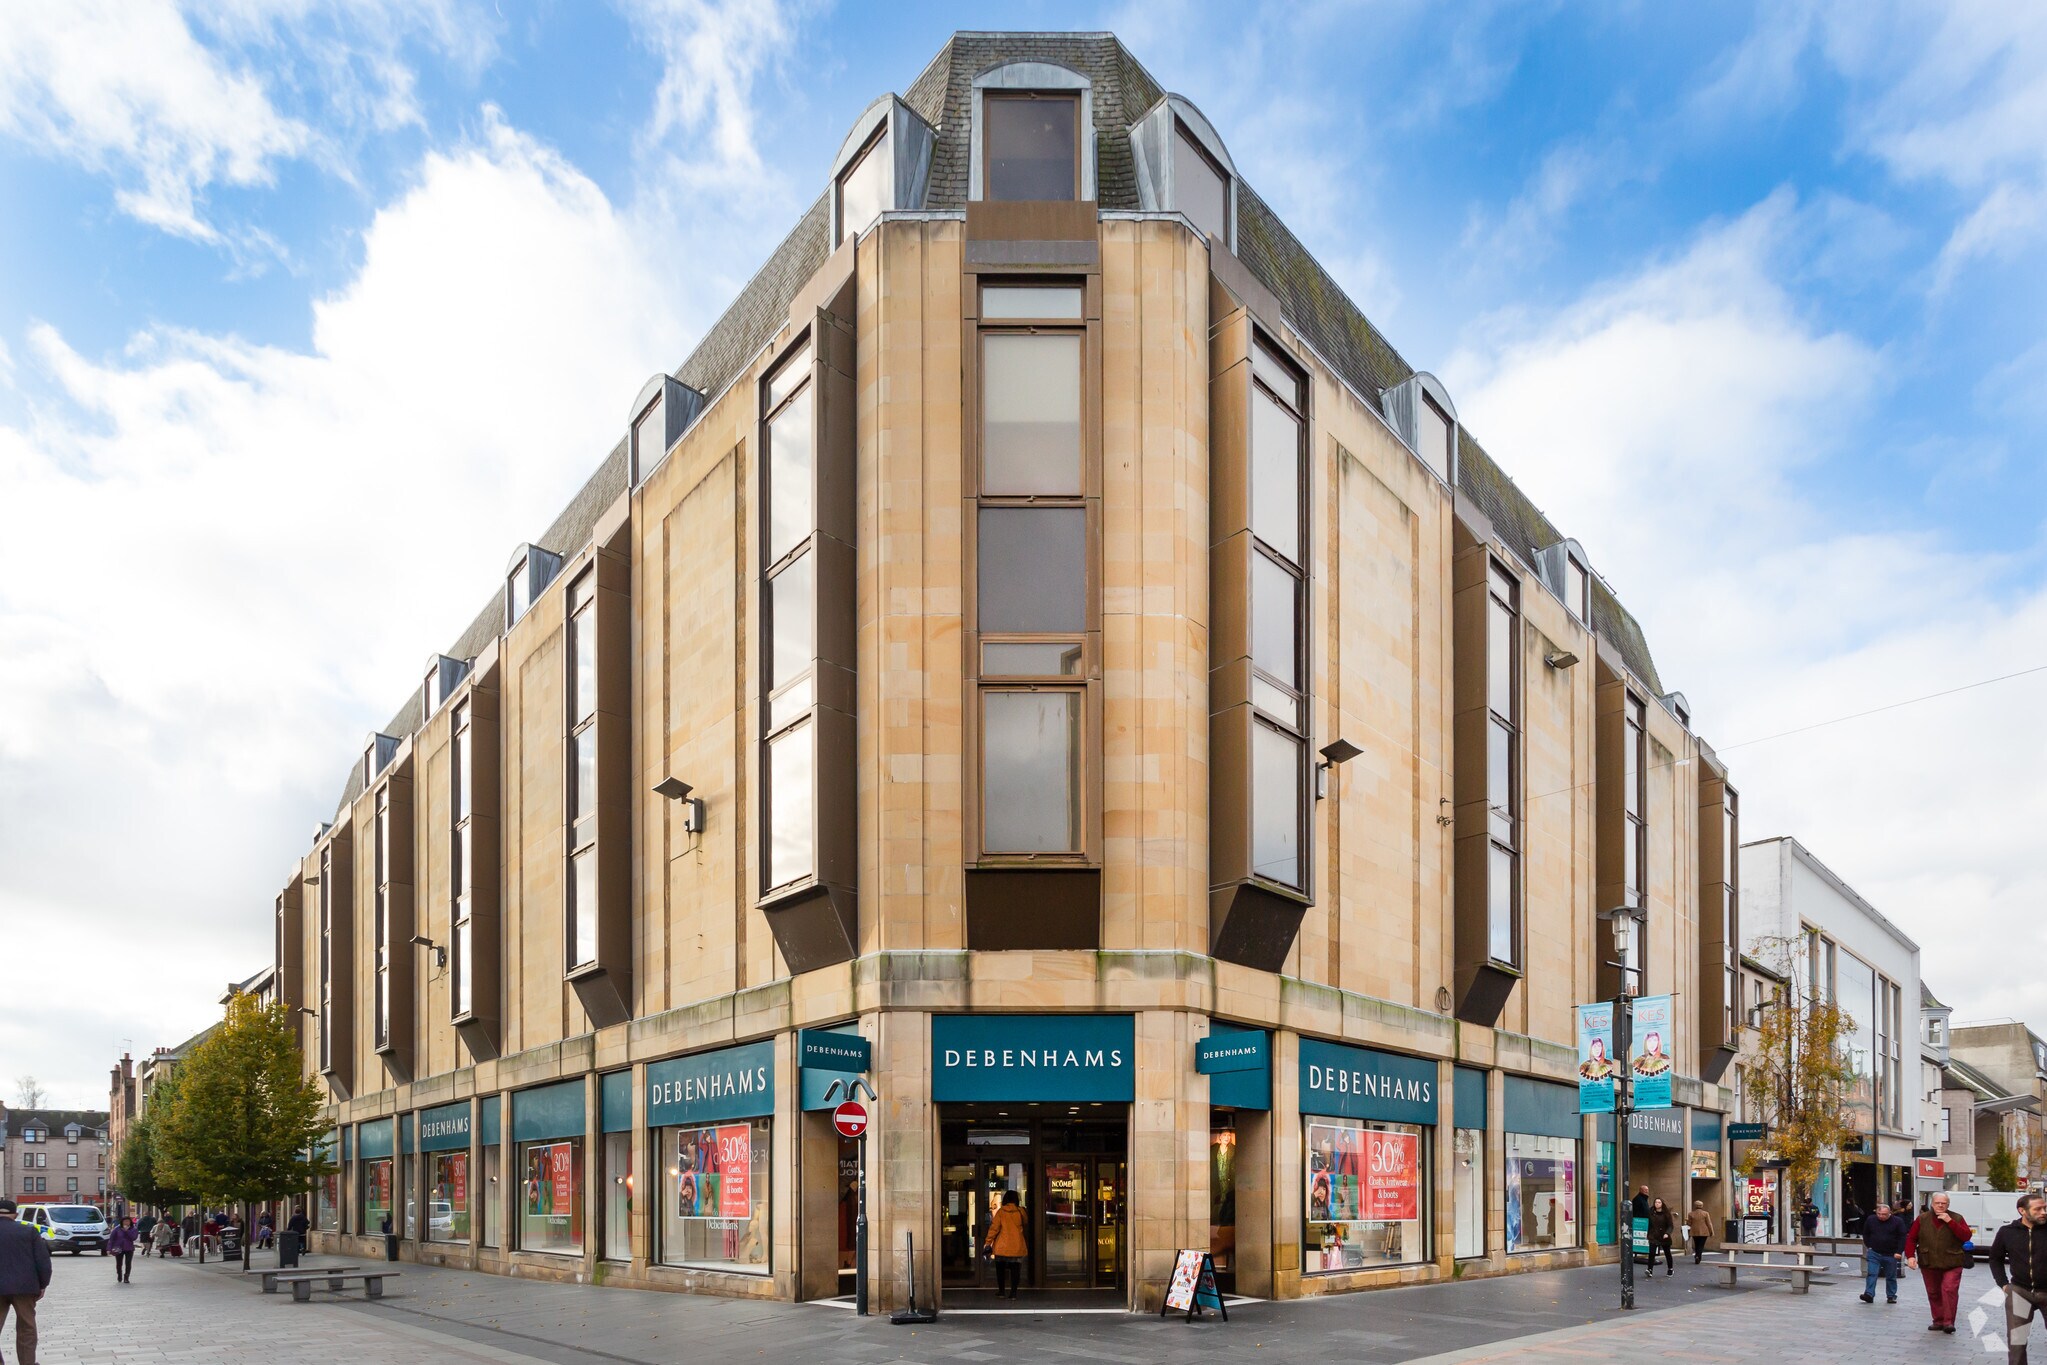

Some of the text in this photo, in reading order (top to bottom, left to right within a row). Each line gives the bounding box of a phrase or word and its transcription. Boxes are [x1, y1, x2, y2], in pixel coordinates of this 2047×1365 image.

[1584, 1015, 1608, 1029] KES
[1638, 1008, 1665, 1022] KES
[806, 1045, 863, 1058] DEBENHAMS
[945, 1050, 1122, 1067] DEBENHAMS
[1203, 1046, 1257, 1060] DEBENHAMS
[652, 1067, 766, 1105] DEBENHAMS
[1309, 1065, 1430, 1103] DEBENHAMS
[422, 1117, 469, 1138] DEBENHAMS
[1632, 1113, 1682, 1134] DEBENHAMS
[721, 1135, 747, 1162] 30%
[553, 1152, 569, 1173] 30%
[1371, 1141, 1405, 1173] 30%
[1051, 1179, 1072, 1188] NCÔME
[1748, 1184, 1773, 1194] Free
[1383, 1189, 1399, 1199] boots
[1749, 1195, 1770, 1205] eye
[1749, 1203, 1771, 1213] test
[705, 1218, 739, 1230] Debenhams
